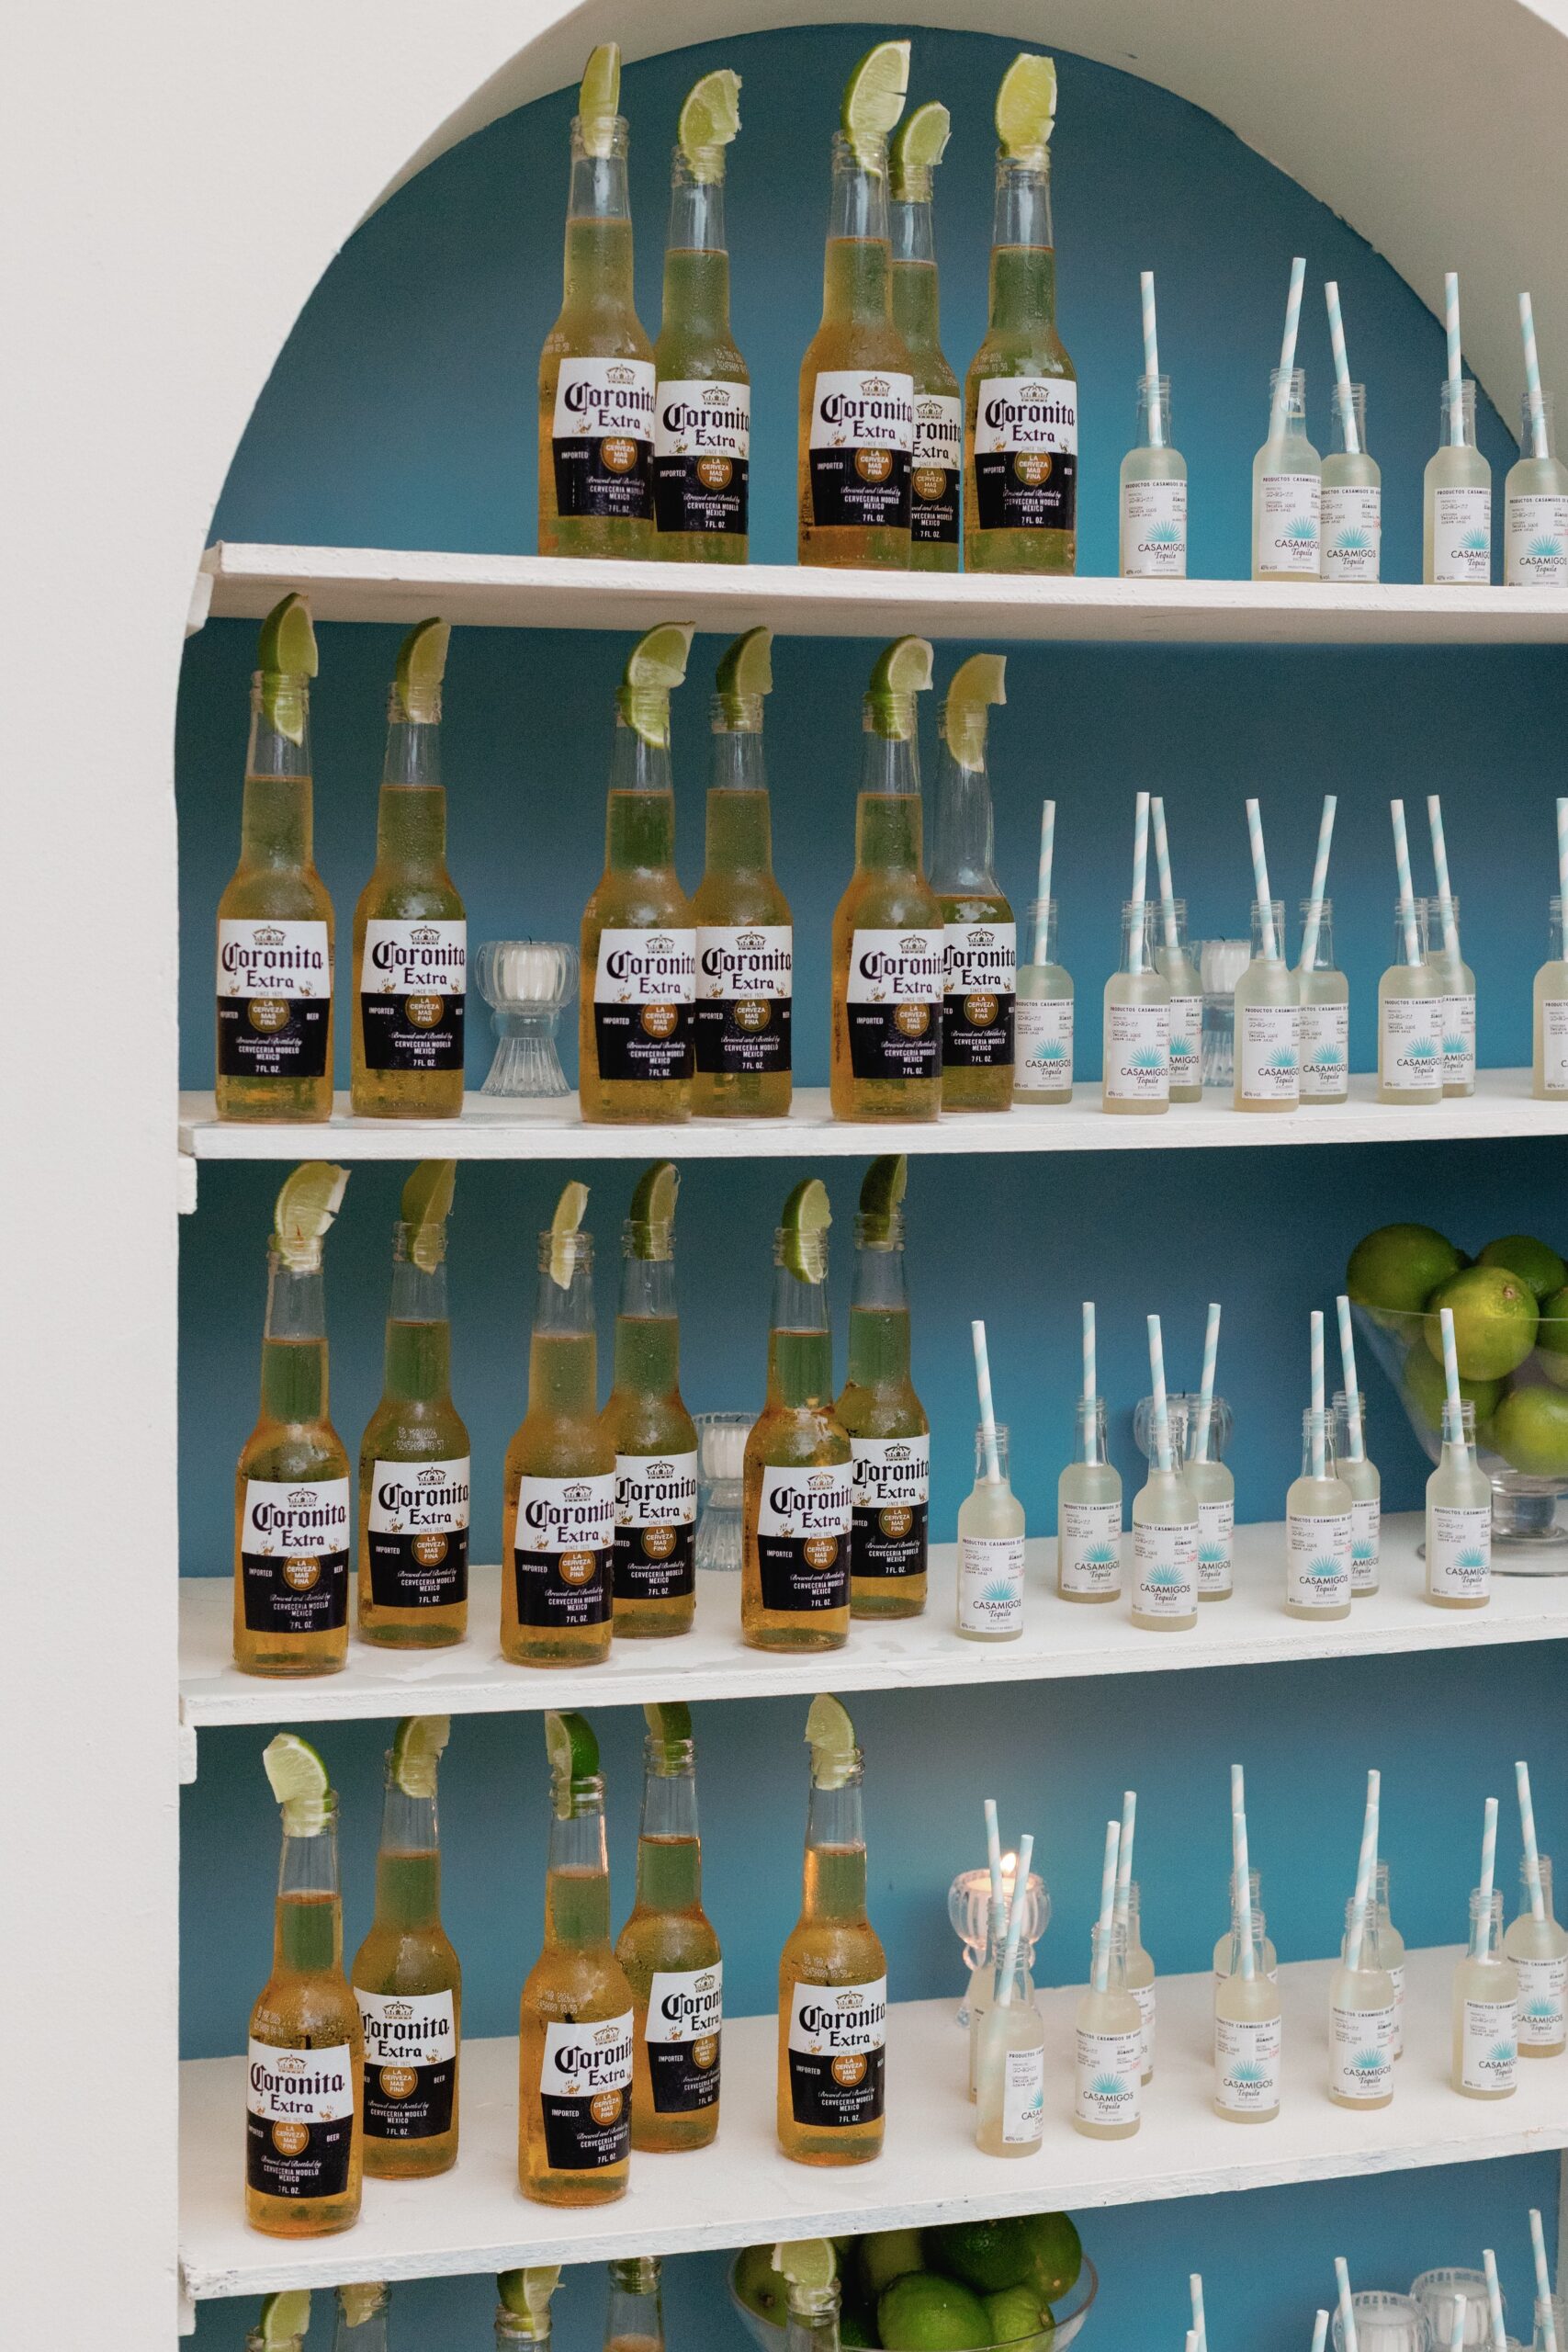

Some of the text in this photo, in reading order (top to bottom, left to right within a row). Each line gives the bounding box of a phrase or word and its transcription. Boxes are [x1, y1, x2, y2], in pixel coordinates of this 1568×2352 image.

[820, 393, 912, 426] Coronita
[986, 399, 1075, 431] Coronita
[598, 410, 640, 429] Extra
[853, 421, 896, 439] Extra
[1012, 424, 1055, 442] Extra
[695, 430, 735, 448] Extra
[913, 442, 949, 459] Extra
[722, 503, 739, 512] MODELO
[1155, 552, 1176, 560] Tequila
[1326, 549, 1376, 558] CASAMIGOS
[1519, 557, 1567, 565] CASAMIGOS
[1342, 558, 1365, 566] Tequila
[1535, 565, 1557, 574] Tequila
[222, 942, 323, 976] Coronita
[372, 940, 465, 973] Coronita
[702, 947, 792, 978] Coronita
[246, 969, 294, 989] Extra
[404, 967, 447, 985] Extra
[732, 974, 774, 989] Extra
[962, 969, 1000, 986] Extra
[639, 978, 681, 994] Extra
[893, 978, 932, 994] Extra
[1025, 1059, 1071, 1068] CASAMIGOS
[1041, 1068, 1062, 1076] Tequila
[1121, 1068, 1168, 1077] CASAMIGOS
[1136, 1077, 1158, 1085] Tequila
[378, 1482, 468, 1514] Coronita
[877, 1484, 915, 1498] Extra
[252, 1502, 346, 1535] Coronita
[410, 1509, 452, 1525] Extra
[639, 1502, 680, 1519] Extra
[802, 1512, 840, 1528] Extra
[282, 1530, 324, 1547] Extra
[558, 1526, 599, 1543] Extra
[1300, 1575, 1348, 1584] CASAMIGOS
[1140, 1583, 1190, 1593] CASAMIGOS
[1314, 1584, 1337, 1593] Tequila
[973, 1599, 1021, 1610] CASAMIGOS
[1154, 1593, 1177, 1602] Tequila
[691, 2015, 719, 2032] Extra
[829, 2031, 870, 2047] Extra
[378, 2040, 422, 2057] Extra
[555, 2037, 633, 2076] Coronit
[589, 2068, 625, 2086] Extra
[1344, 2064, 1391, 2076] CASAMIGOS
[251, 2063, 344, 2096] Coronita
[434, 2075, 446, 2084] BEER
[1224, 2078, 1273, 2088] CASAMIGOS
[1083, 2091, 1134, 2102] CASAMIGOS
[1237, 2089, 1260, 2098] Tequila
[270, 2094, 313, 2113] Extra
[1097, 2101, 1120, 2111] Tequila
[327, 2133, 340, 2143] BEER
